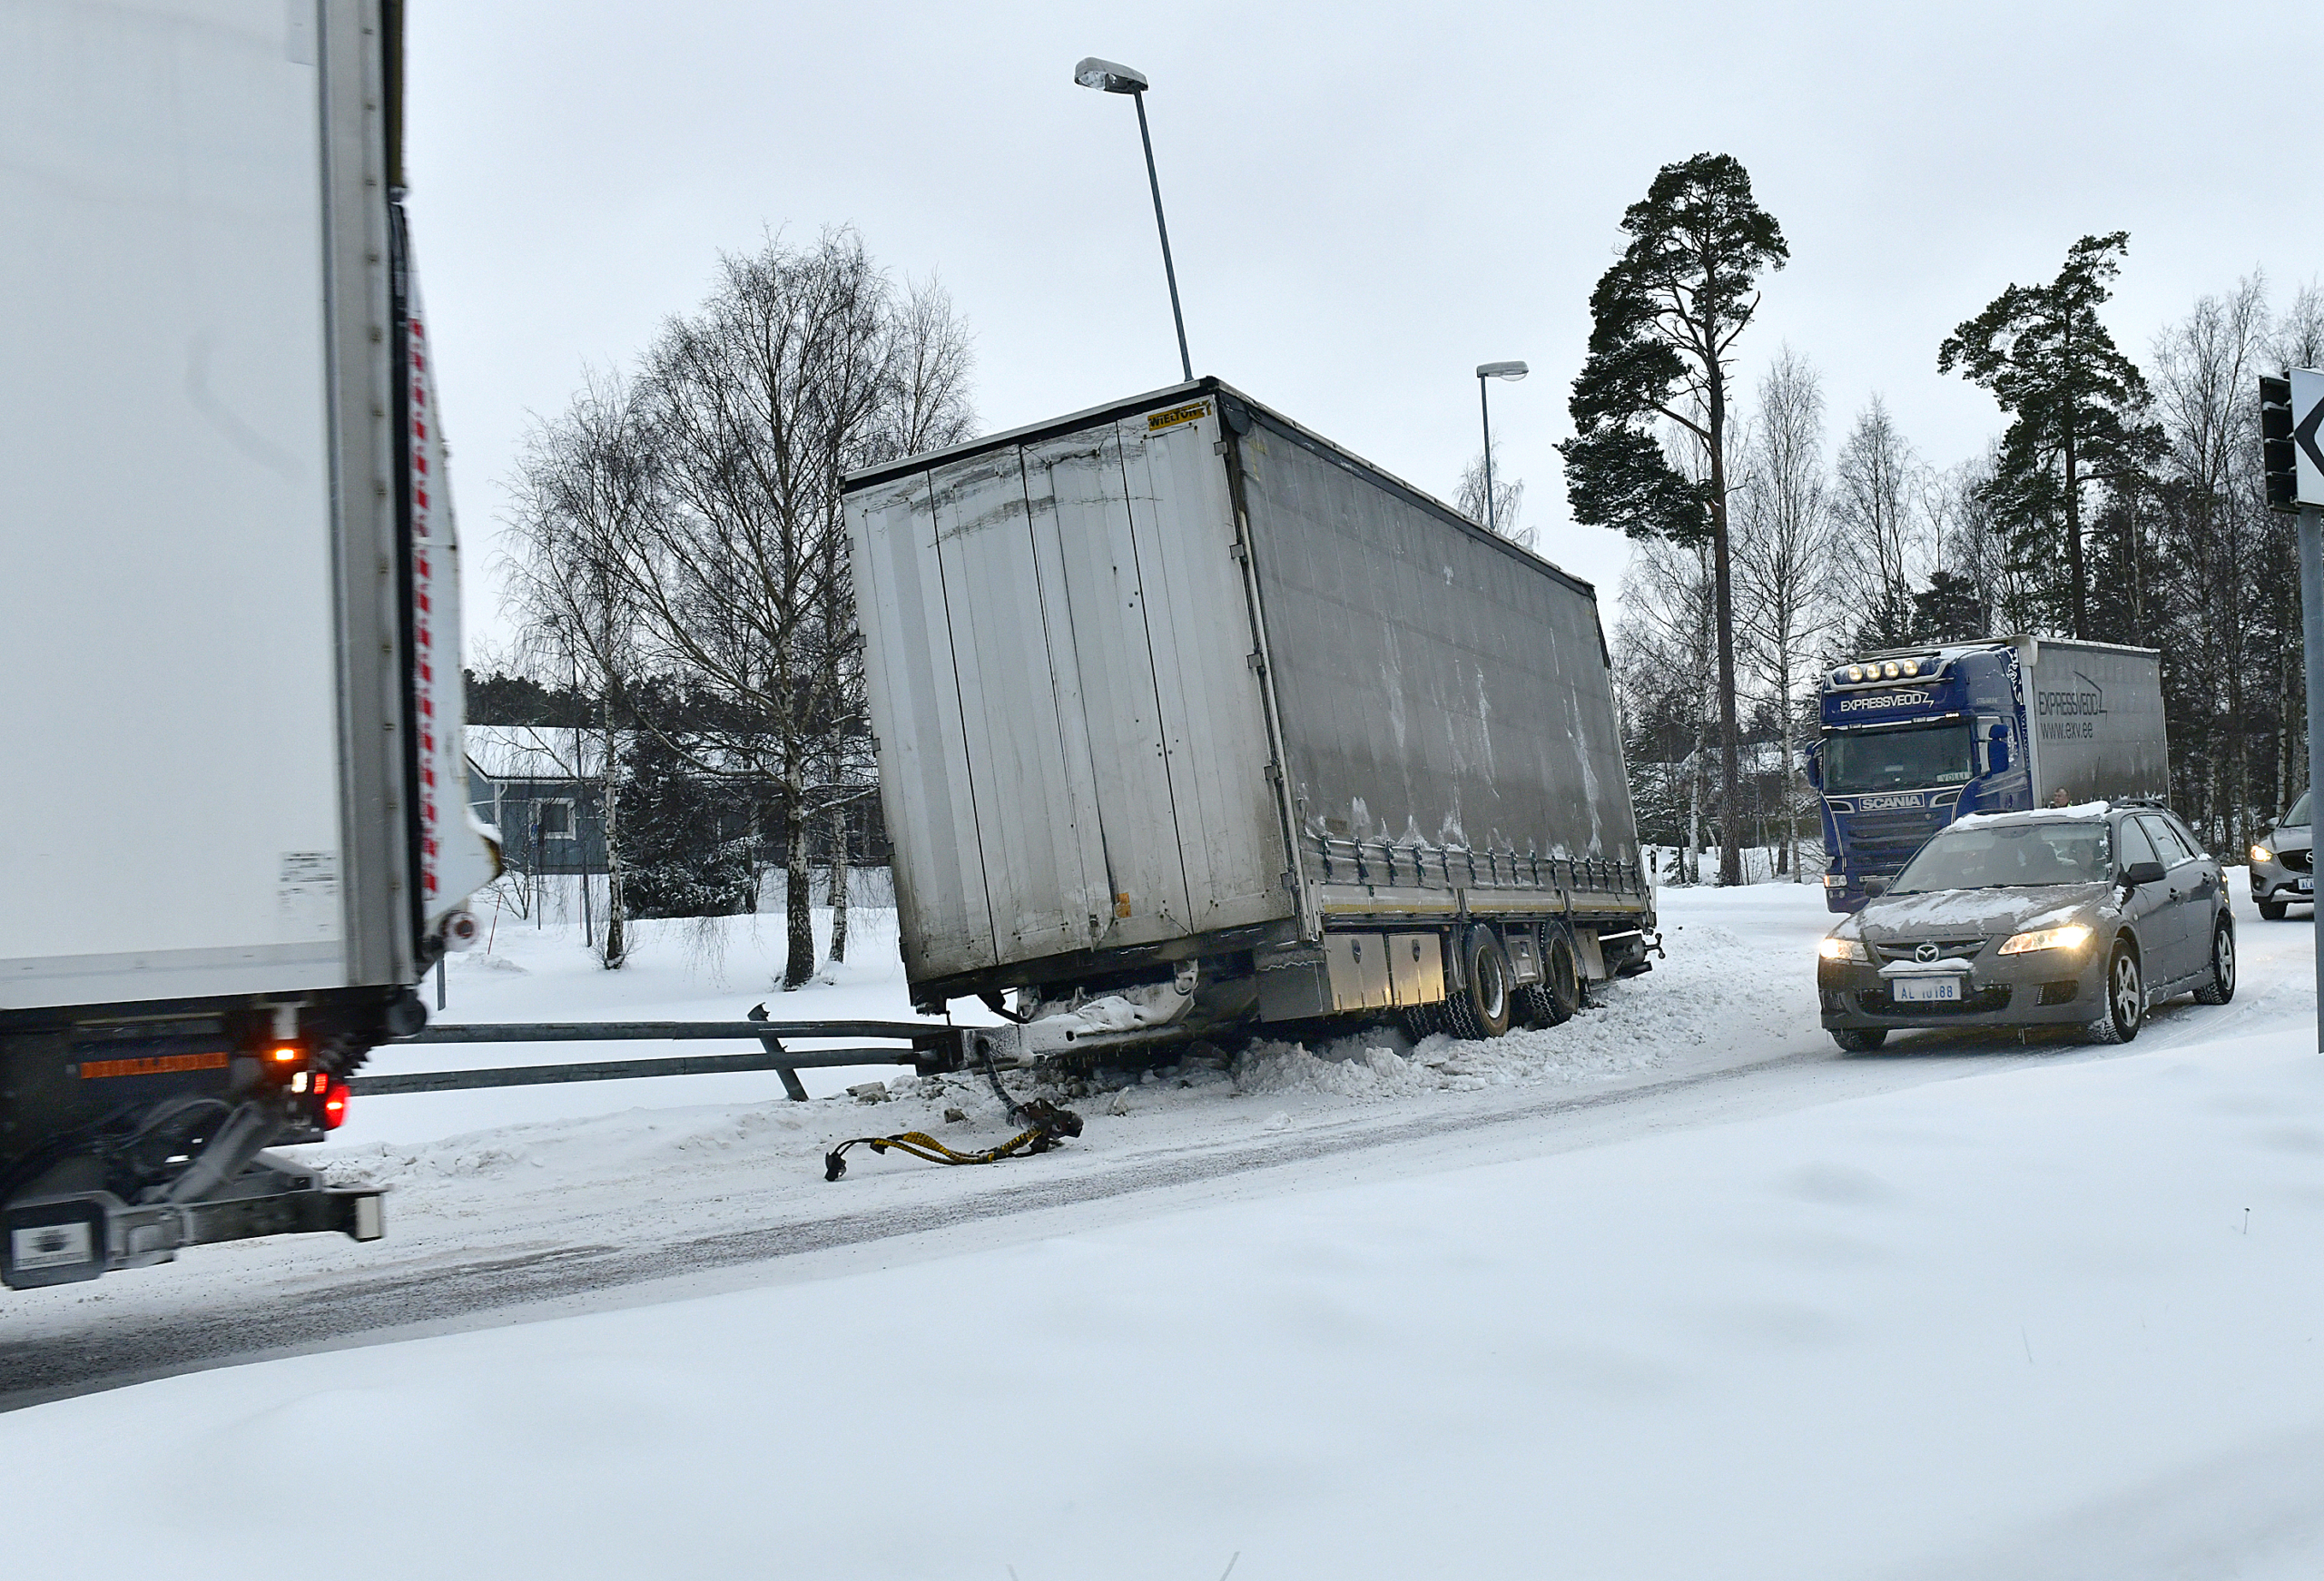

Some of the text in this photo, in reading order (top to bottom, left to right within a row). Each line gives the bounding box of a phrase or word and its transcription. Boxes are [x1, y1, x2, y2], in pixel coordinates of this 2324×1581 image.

[1149, 406, 1197, 427] WIELTON
[1840, 693, 1922, 712] EXPRESSVEOD
[2038, 692, 2099, 715] EXPRESSVEOD
[2040, 722, 2093, 740] www.exv.ee
[1942, 772, 1965, 781] VOLLI
[1862, 795, 1922, 810] SCANIA
